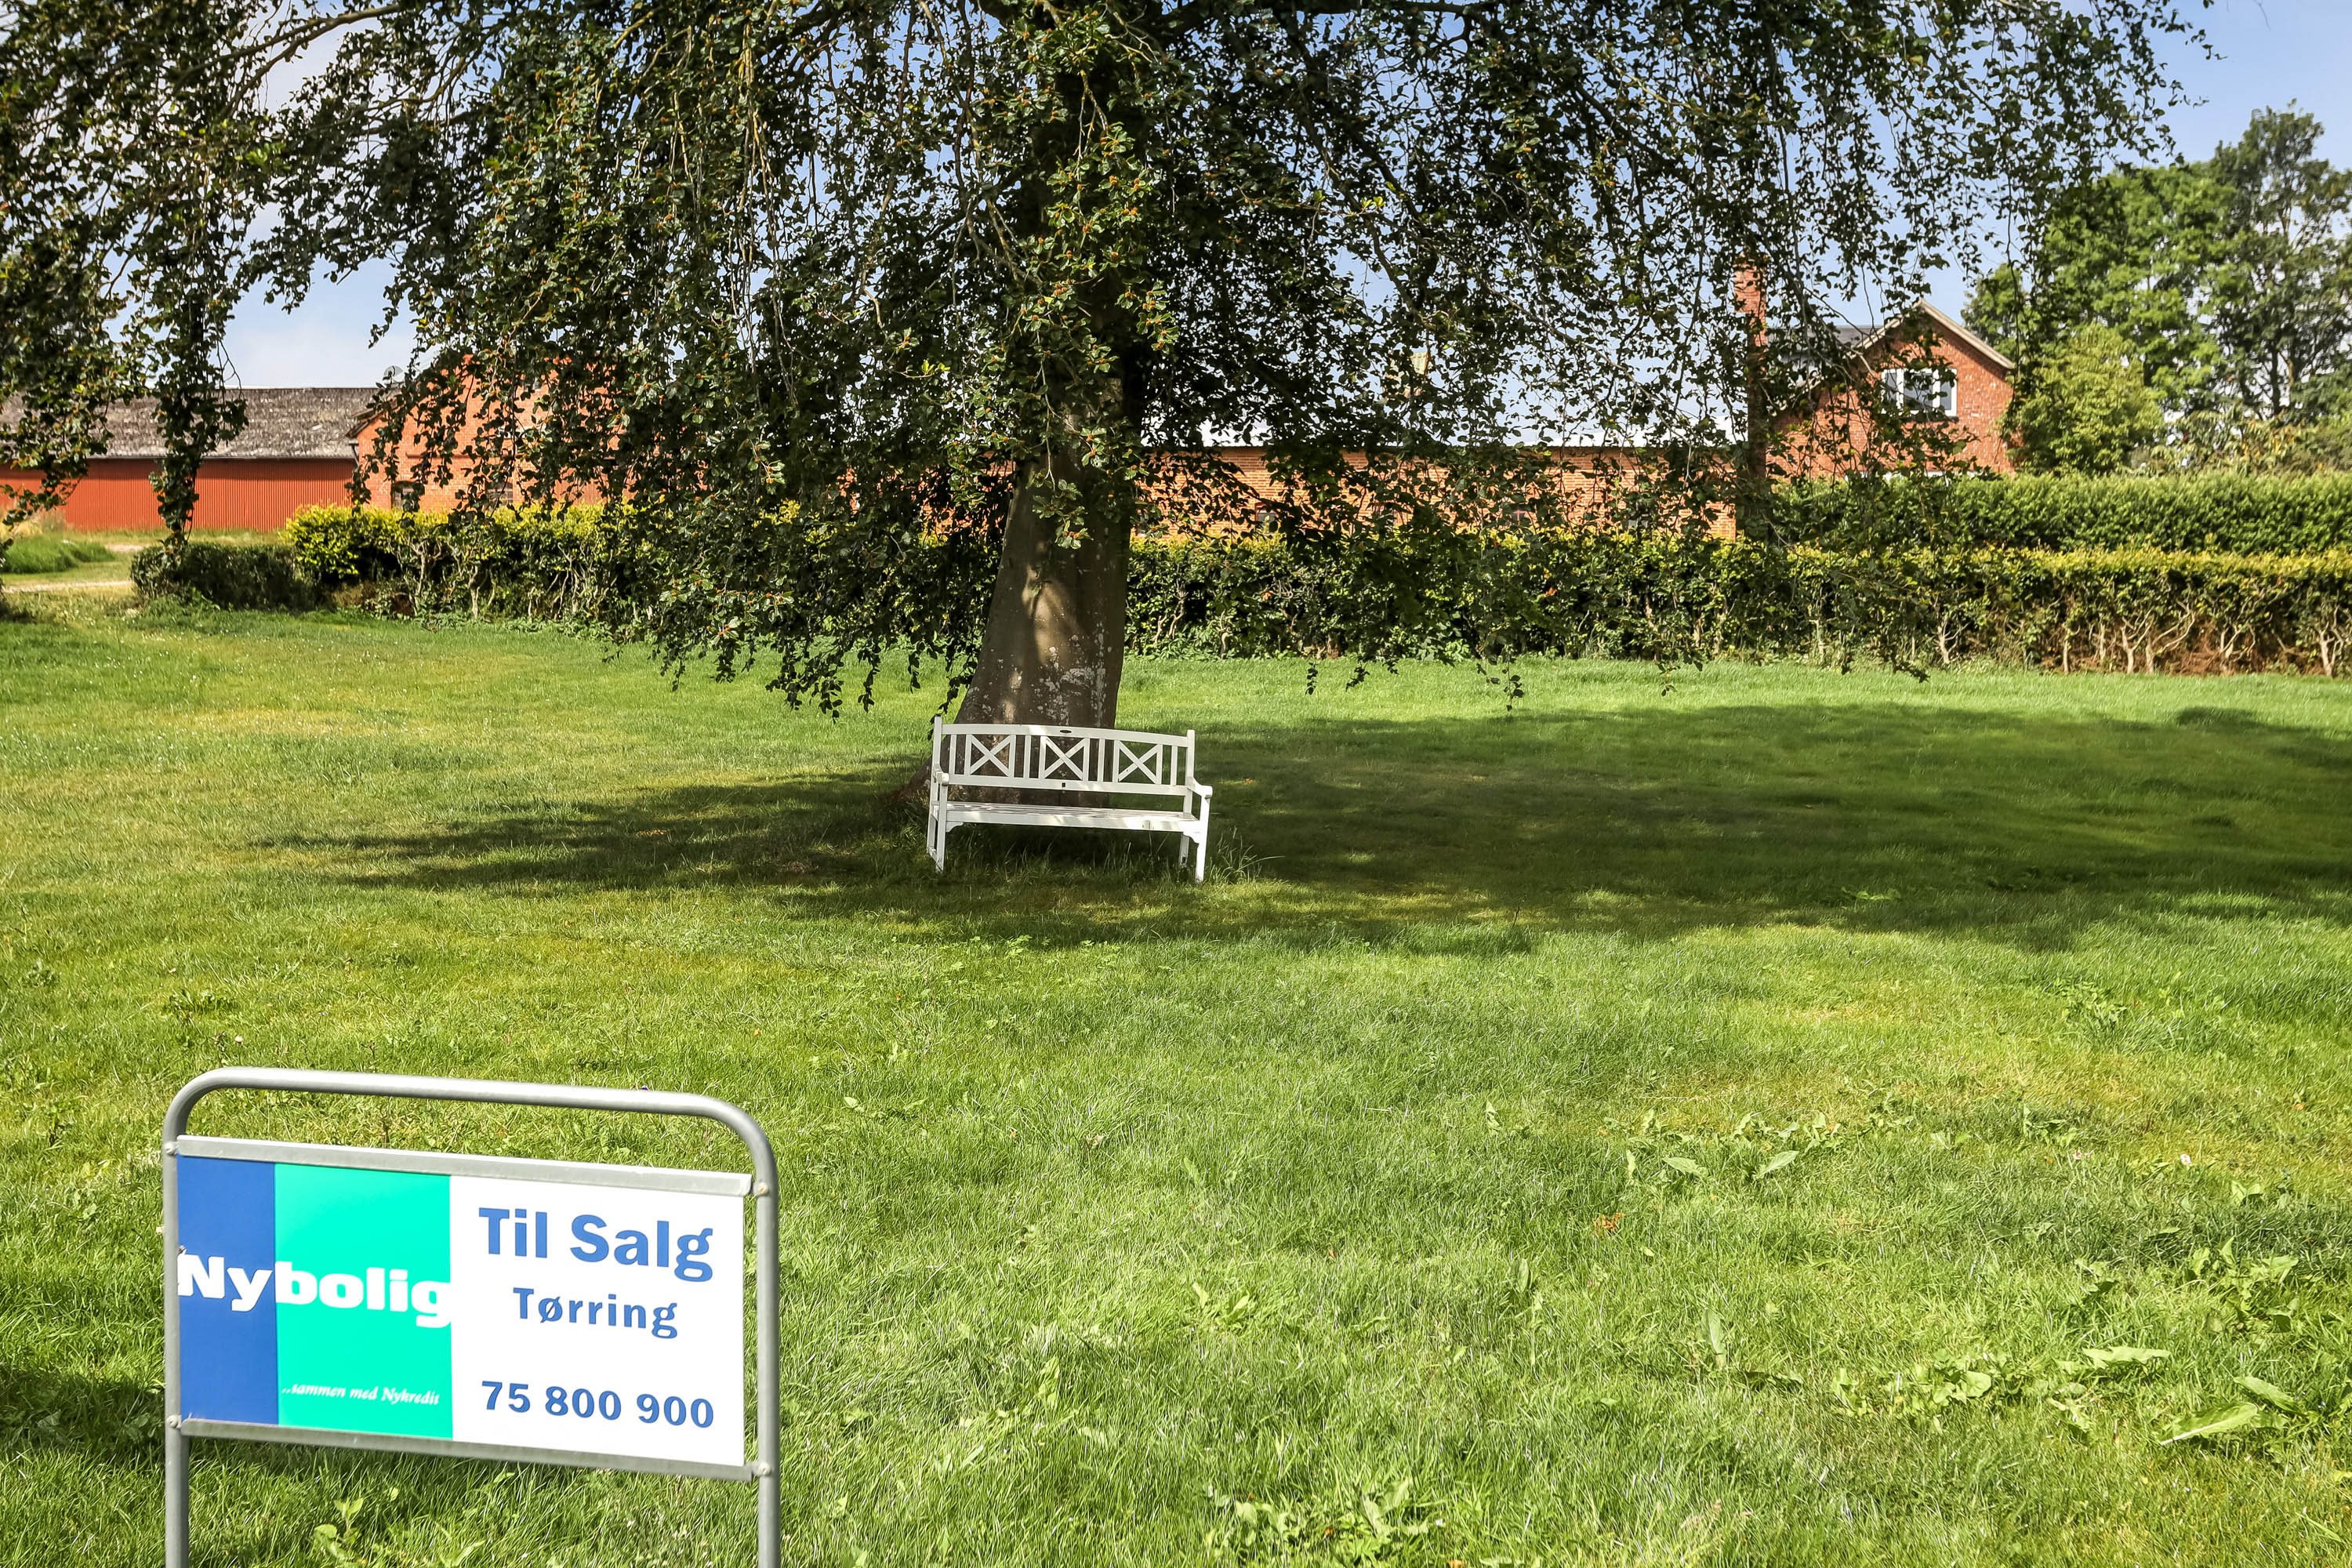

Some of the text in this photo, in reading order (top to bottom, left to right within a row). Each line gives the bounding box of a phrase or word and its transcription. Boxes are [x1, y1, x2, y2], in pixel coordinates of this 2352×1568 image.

[478, 1207, 713, 1283] Til Salg
[177, 1254, 452, 1329] Nybolig
[513, 1287, 678, 1339] Tørring
[349, 1386, 379, 1400] med
[381, 1387, 440, 1405] Nykredit
[481, 1380, 714, 1428] 75 800 900
